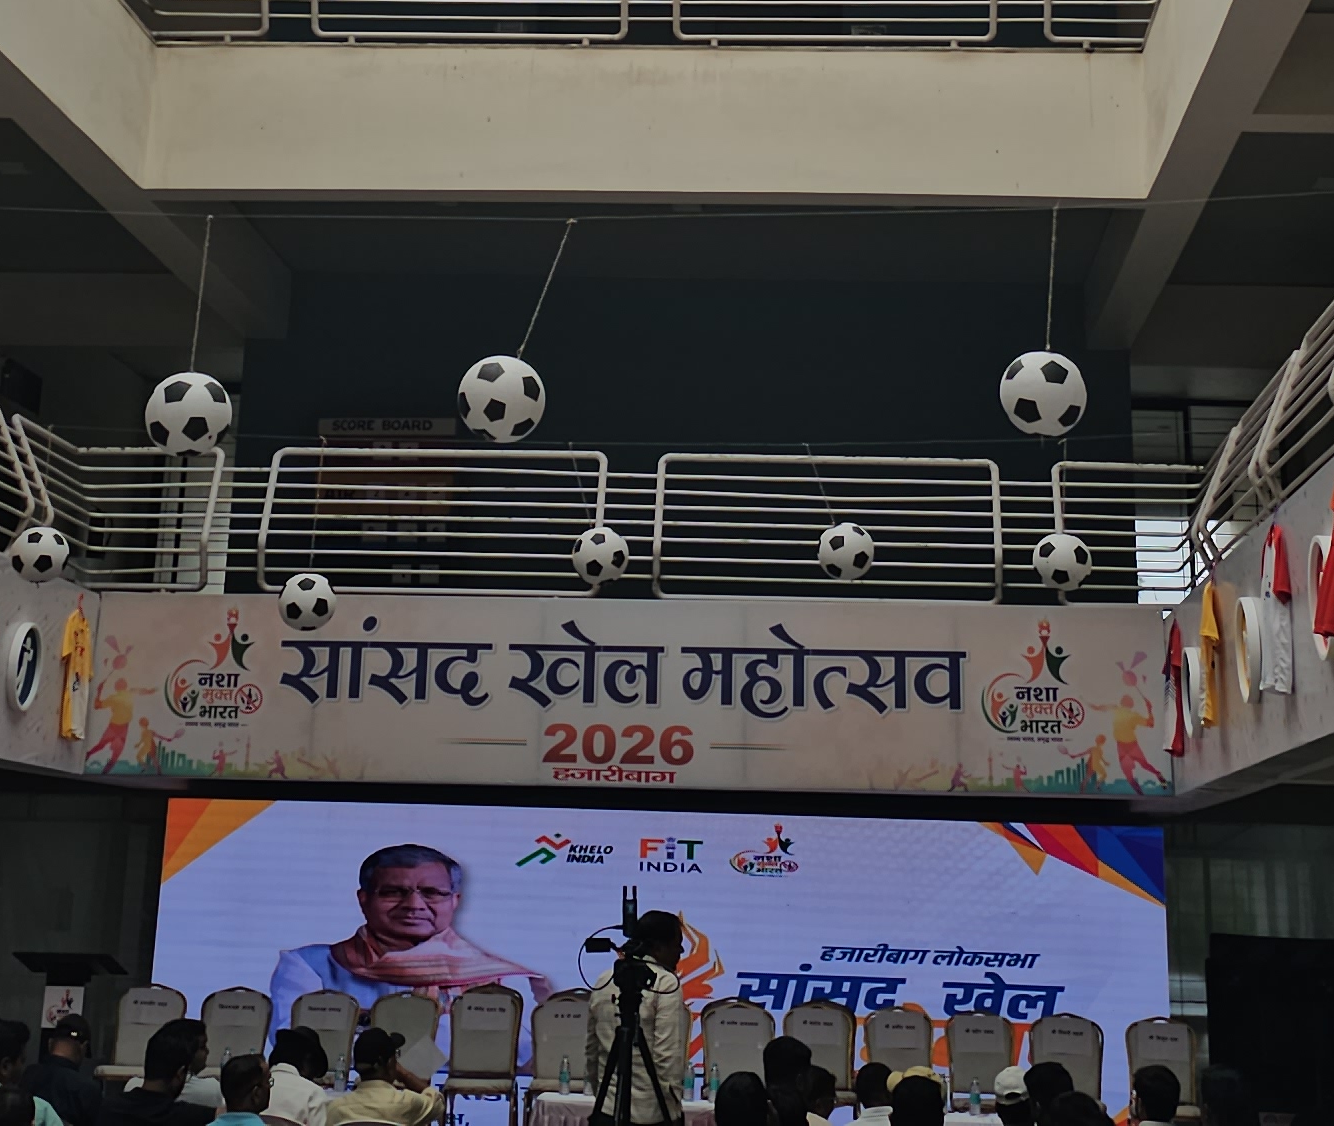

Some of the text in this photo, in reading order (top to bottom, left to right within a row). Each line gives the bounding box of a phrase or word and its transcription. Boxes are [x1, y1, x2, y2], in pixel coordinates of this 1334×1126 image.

[332, 419, 433, 431] SCORE BOARD
[279, 616, 967, 719] सांसद खेल महोत्सव
[197, 673, 240, 688] नशा
[1014, 686, 1059, 702] नशा
[198, 705, 240, 719] भारत
[1020, 720, 1062, 734] भारत
[542, 723, 694, 766] 2026
[552, 764, 676, 784] हजारीबाग
[568, 844, 614, 855] KHELO
[566, 854, 605, 864] INDIA
[639, 861, 702, 874] INDIA
[820, 943, 1041, 969] हजारीबाग लोकसभा
[942, 972, 1065, 1019] खेल
